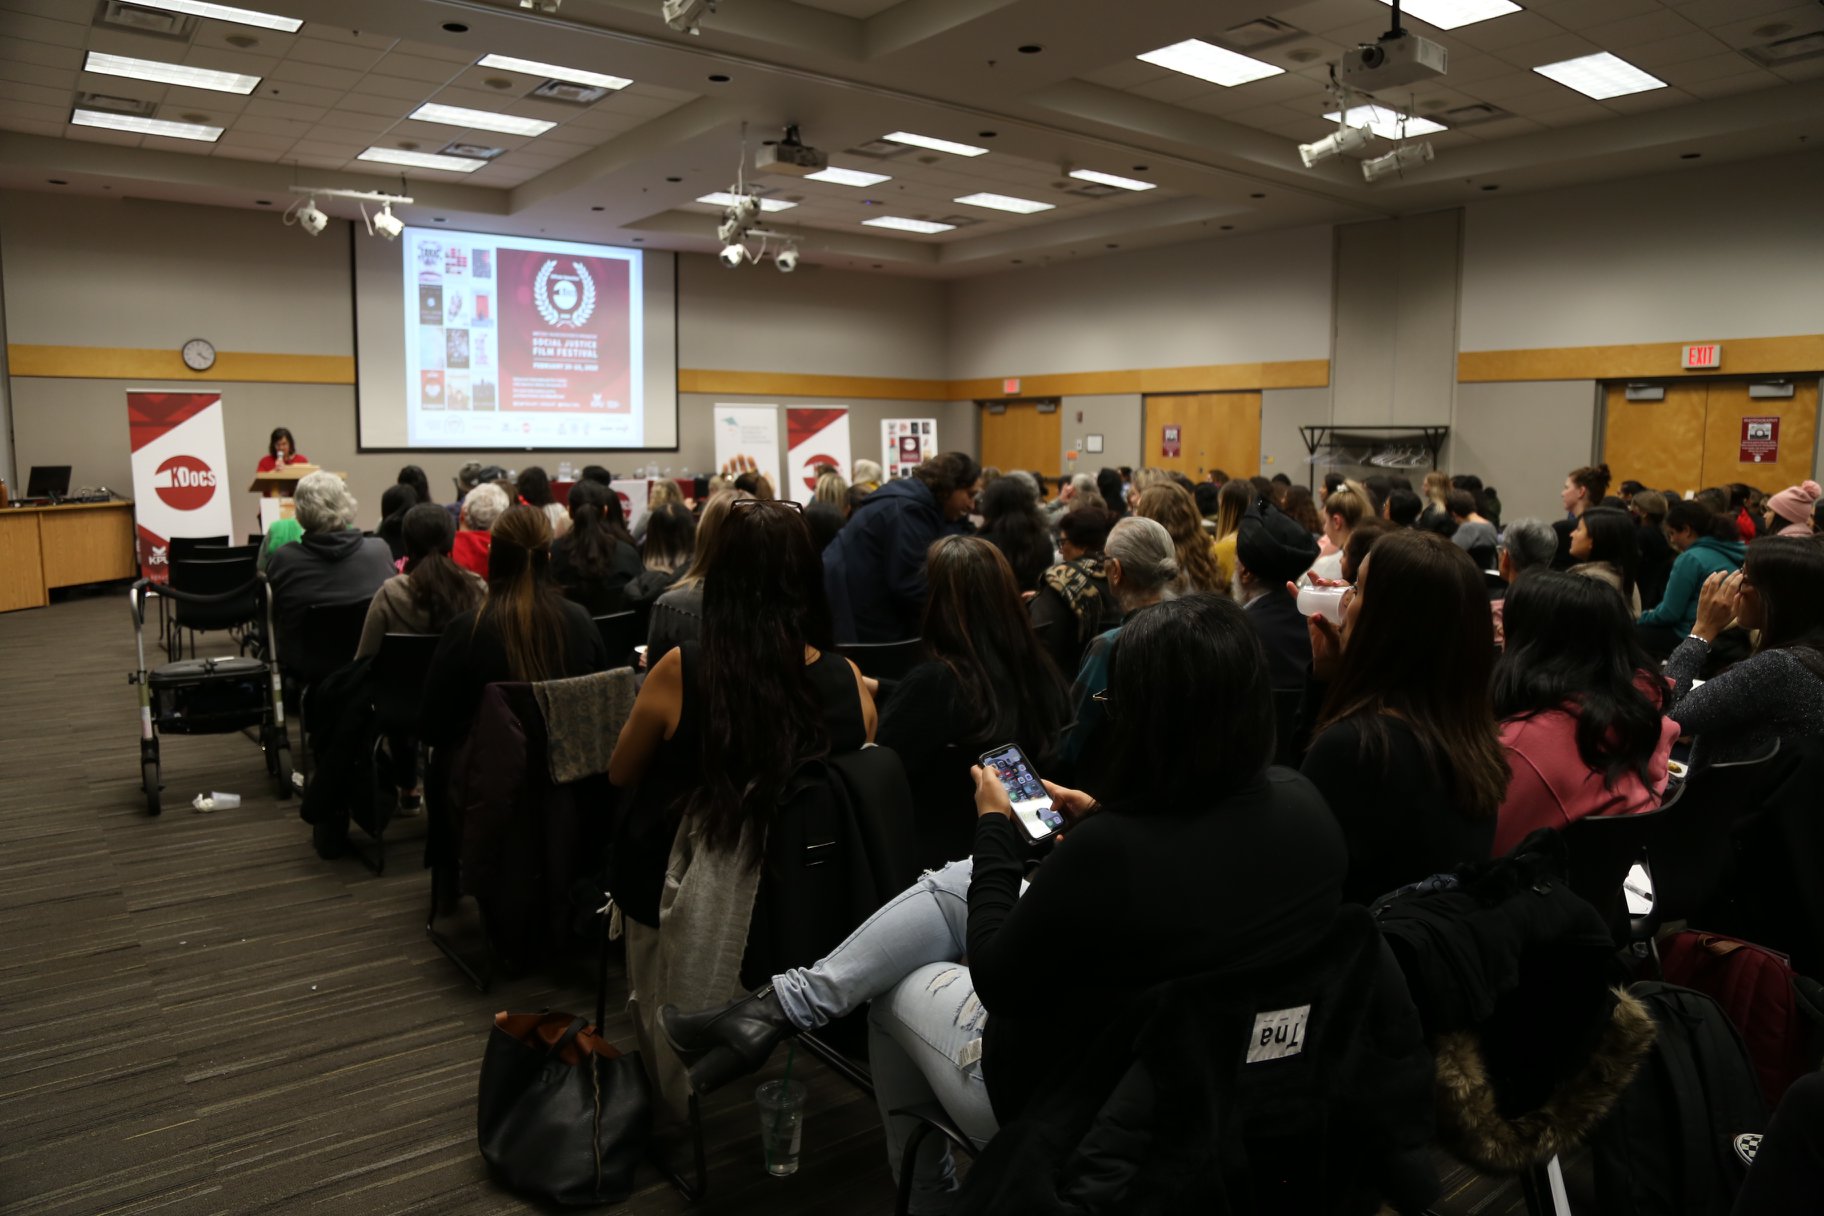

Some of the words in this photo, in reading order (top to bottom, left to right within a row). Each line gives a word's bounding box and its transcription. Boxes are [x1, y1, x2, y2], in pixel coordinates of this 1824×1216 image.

[532, 338, 561, 347] SOCIAL
[565, 339, 598, 349] JUSTICE
[532, 347, 555, 357] FILM
[556, 348, 599, 359] FESTIVAL
[1688, 346, 1715, 366] EXIT
